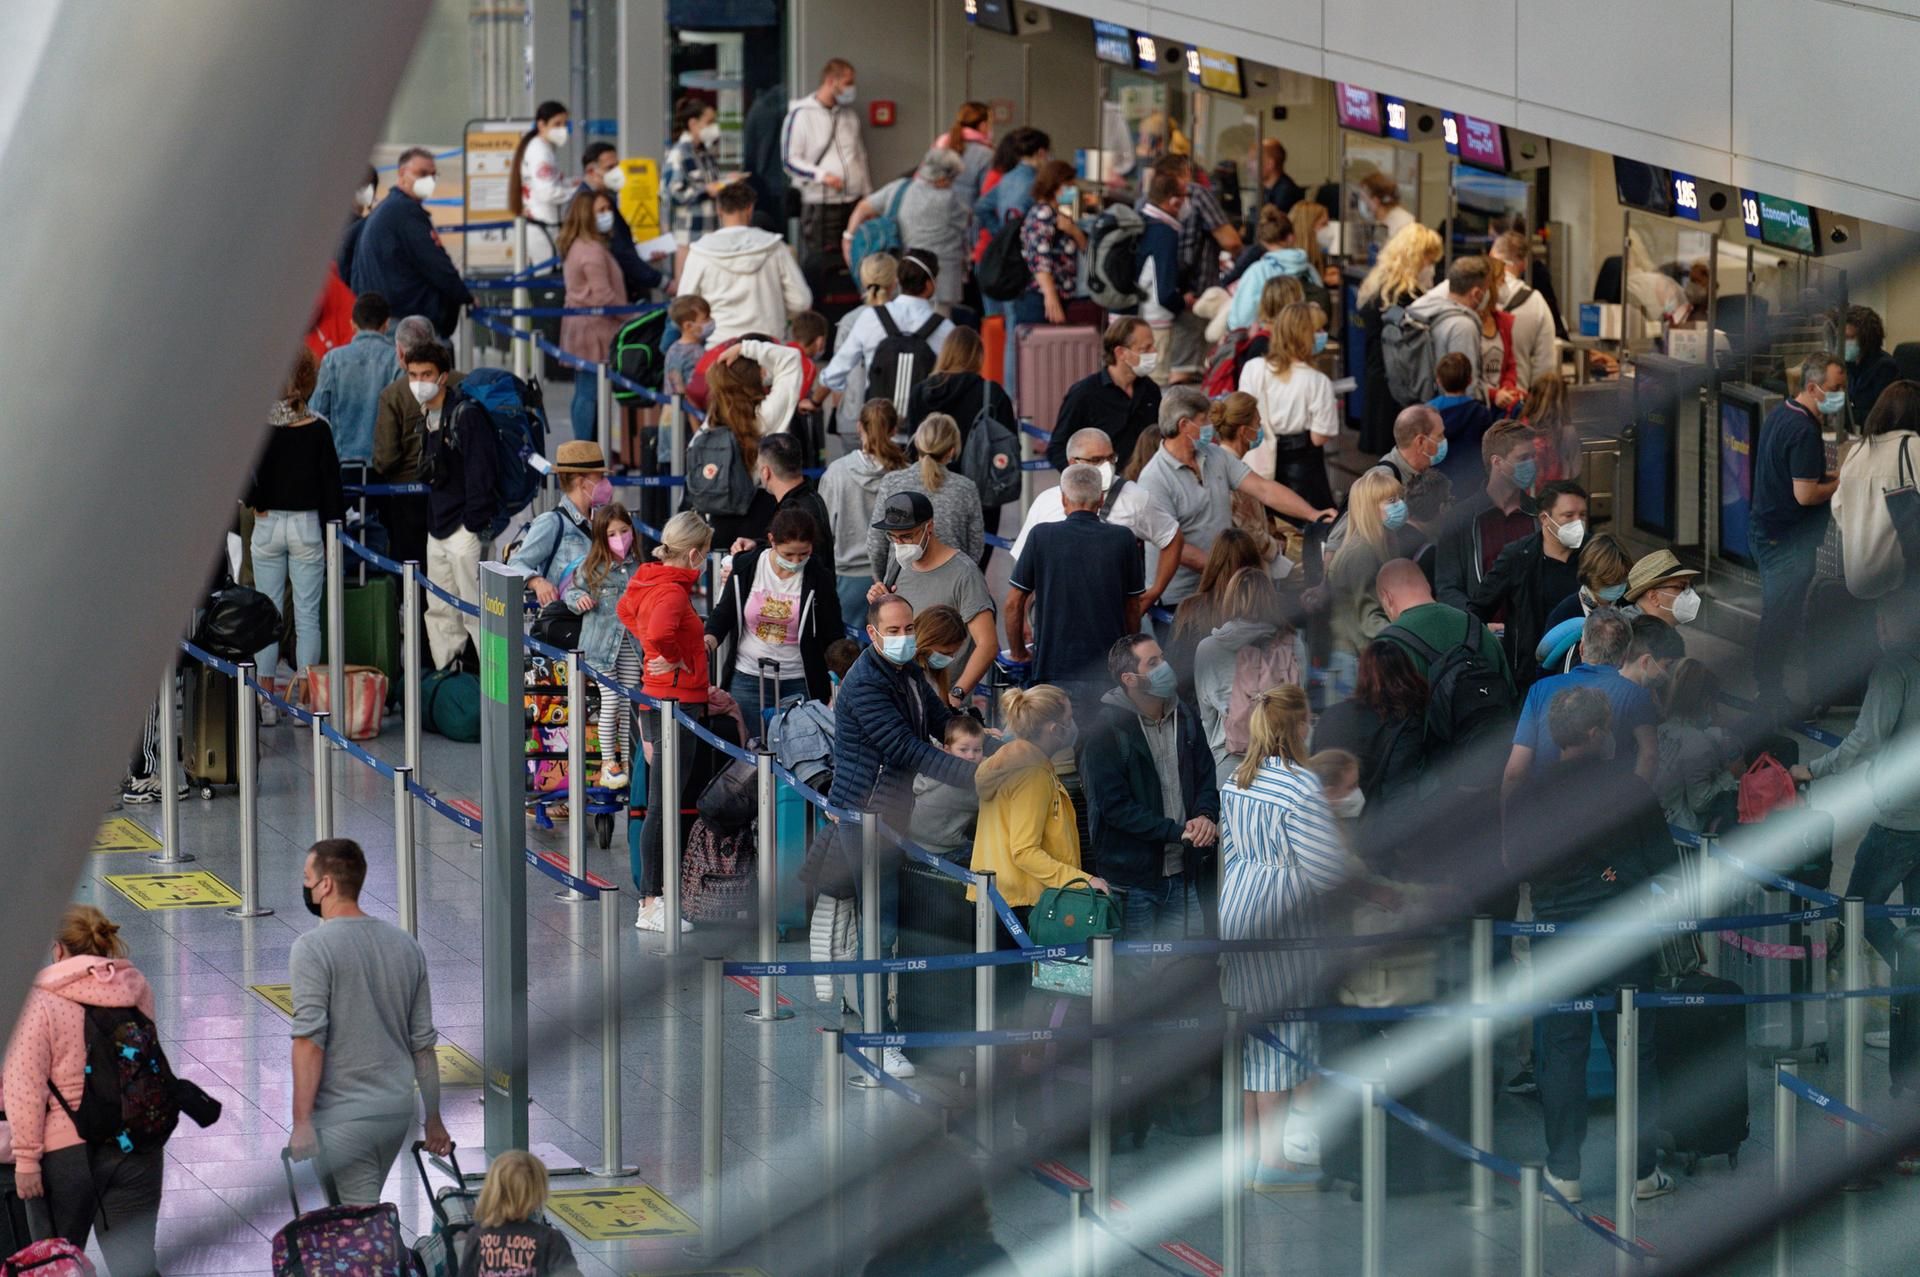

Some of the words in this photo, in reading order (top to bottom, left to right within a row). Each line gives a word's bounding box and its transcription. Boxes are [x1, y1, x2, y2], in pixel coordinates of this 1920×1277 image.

[1675, 179, 1697, 209] 185
[1761, 202, 1792, 228] Economy
[1791, 207, 1810, 229] Class
[1803, 908, 1822, 919] DUS
[1535, 923, 1556, 933] DUS
[1678, 920, 1698, 930] DUS
[1047, 947, 1066, 958] DUS
[1152, 943, 1173, 952] DUS
[767, 965, 787, 975] DUS
[907, 960, 927, 970] DUS
[1573, 1000, 1594, 1010] DUS
[1685, 995, 1704, 1005] DUS
[885, 1034, 906, 1045] DUS
[1032, 1030, 1053, 1040] DUS
[480, 1234, 500, 1248] YOU
[507, 1235, 536, 1249] LOOK
